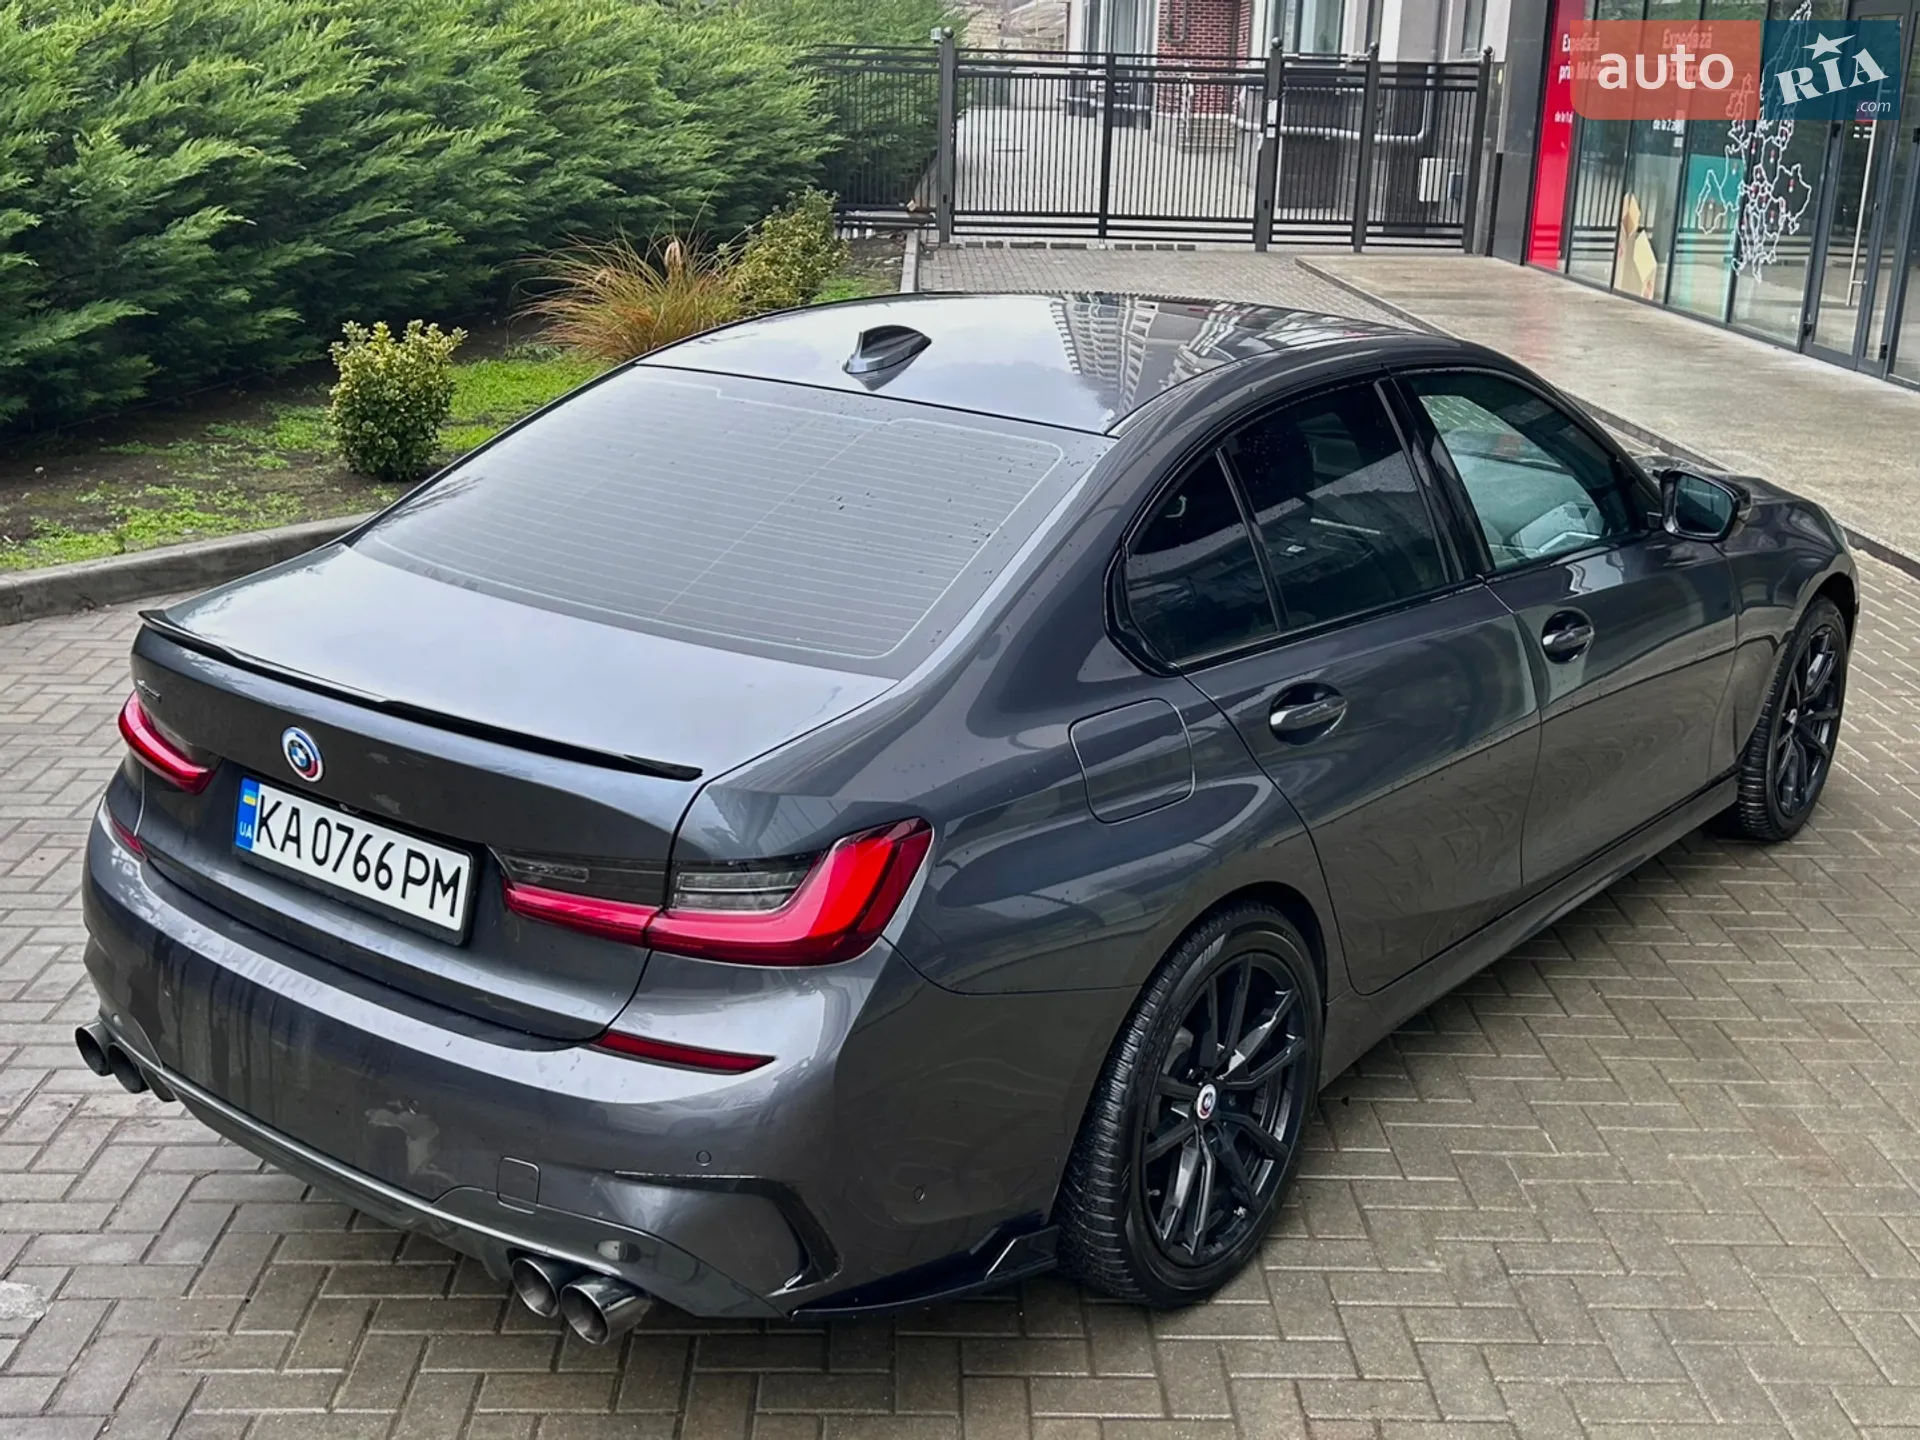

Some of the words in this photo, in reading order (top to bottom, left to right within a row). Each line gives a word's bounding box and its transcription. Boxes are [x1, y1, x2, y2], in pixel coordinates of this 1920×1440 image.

[239, 821, 253, 838] UA
[256, 794, 301, 859] KA
[311, 817, 395, 891] 0766
[400, 849, 462, 918] PM
